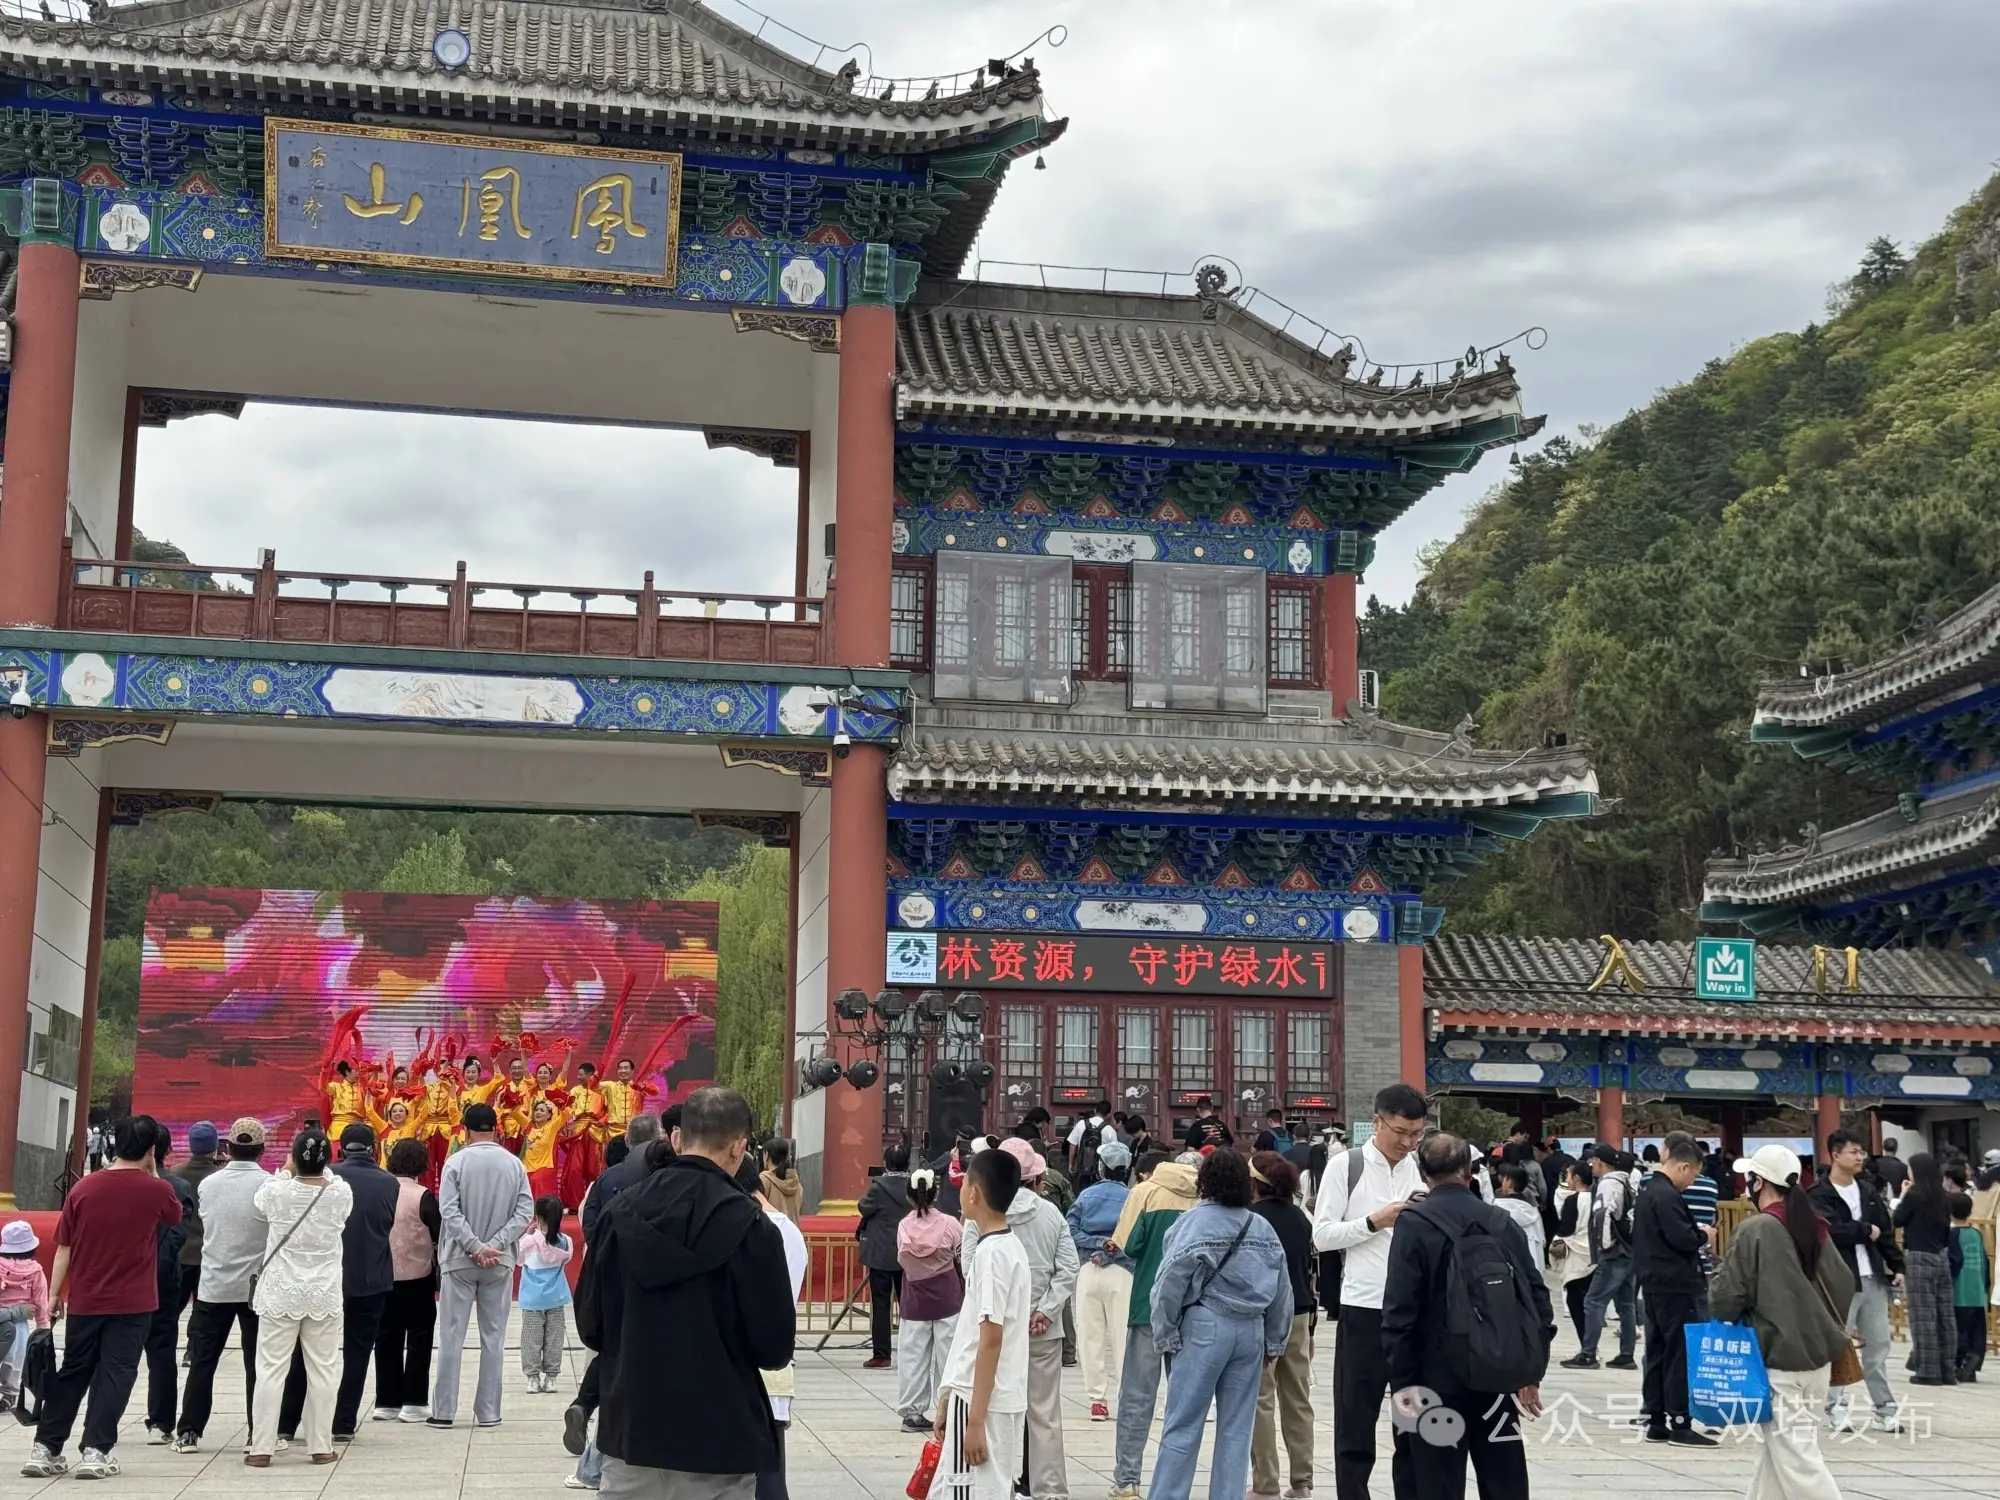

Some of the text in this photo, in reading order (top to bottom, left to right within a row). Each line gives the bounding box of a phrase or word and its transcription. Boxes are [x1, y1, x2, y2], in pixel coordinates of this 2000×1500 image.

[1705, 981, 1746, 994] Way in
[1017, 1115, 1024, 1124] 2
[1252, 1120, 1258, 1128] 4
